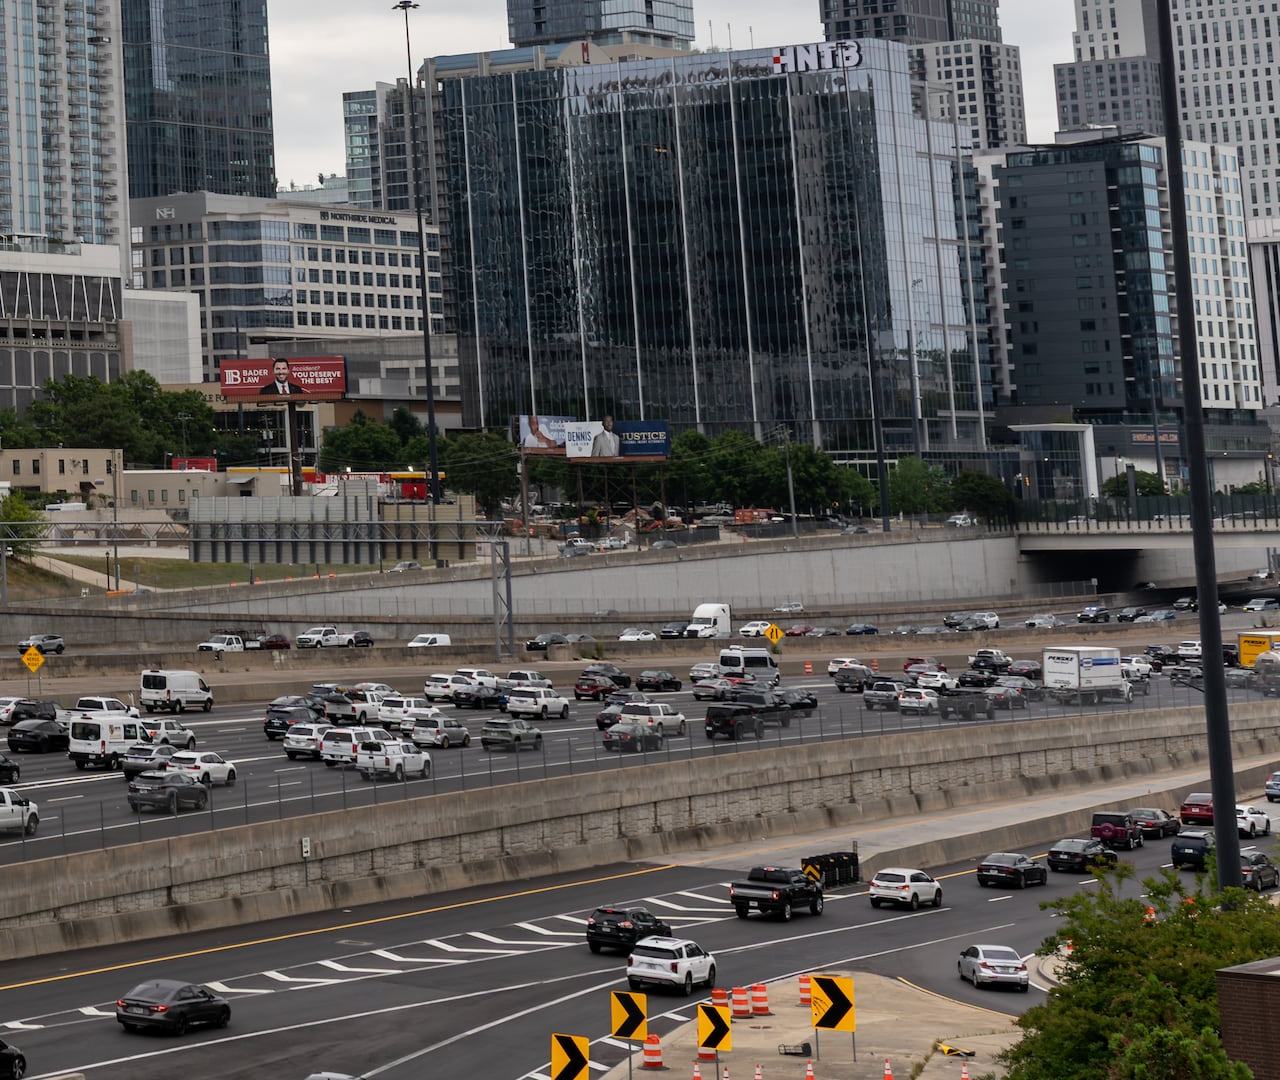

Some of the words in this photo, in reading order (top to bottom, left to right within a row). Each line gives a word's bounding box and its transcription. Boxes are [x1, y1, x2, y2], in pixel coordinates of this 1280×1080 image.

[773, 41, 861, 74] HNTB
[330, 212, 368, 223] NORTHSIDE
[368, 215, 397, 225] MEDICAL
[243, 369, 268, 377] BADER
[568, 432, 591, 441] DENNIS
[622, 431, 666, 440] JUSTICE
